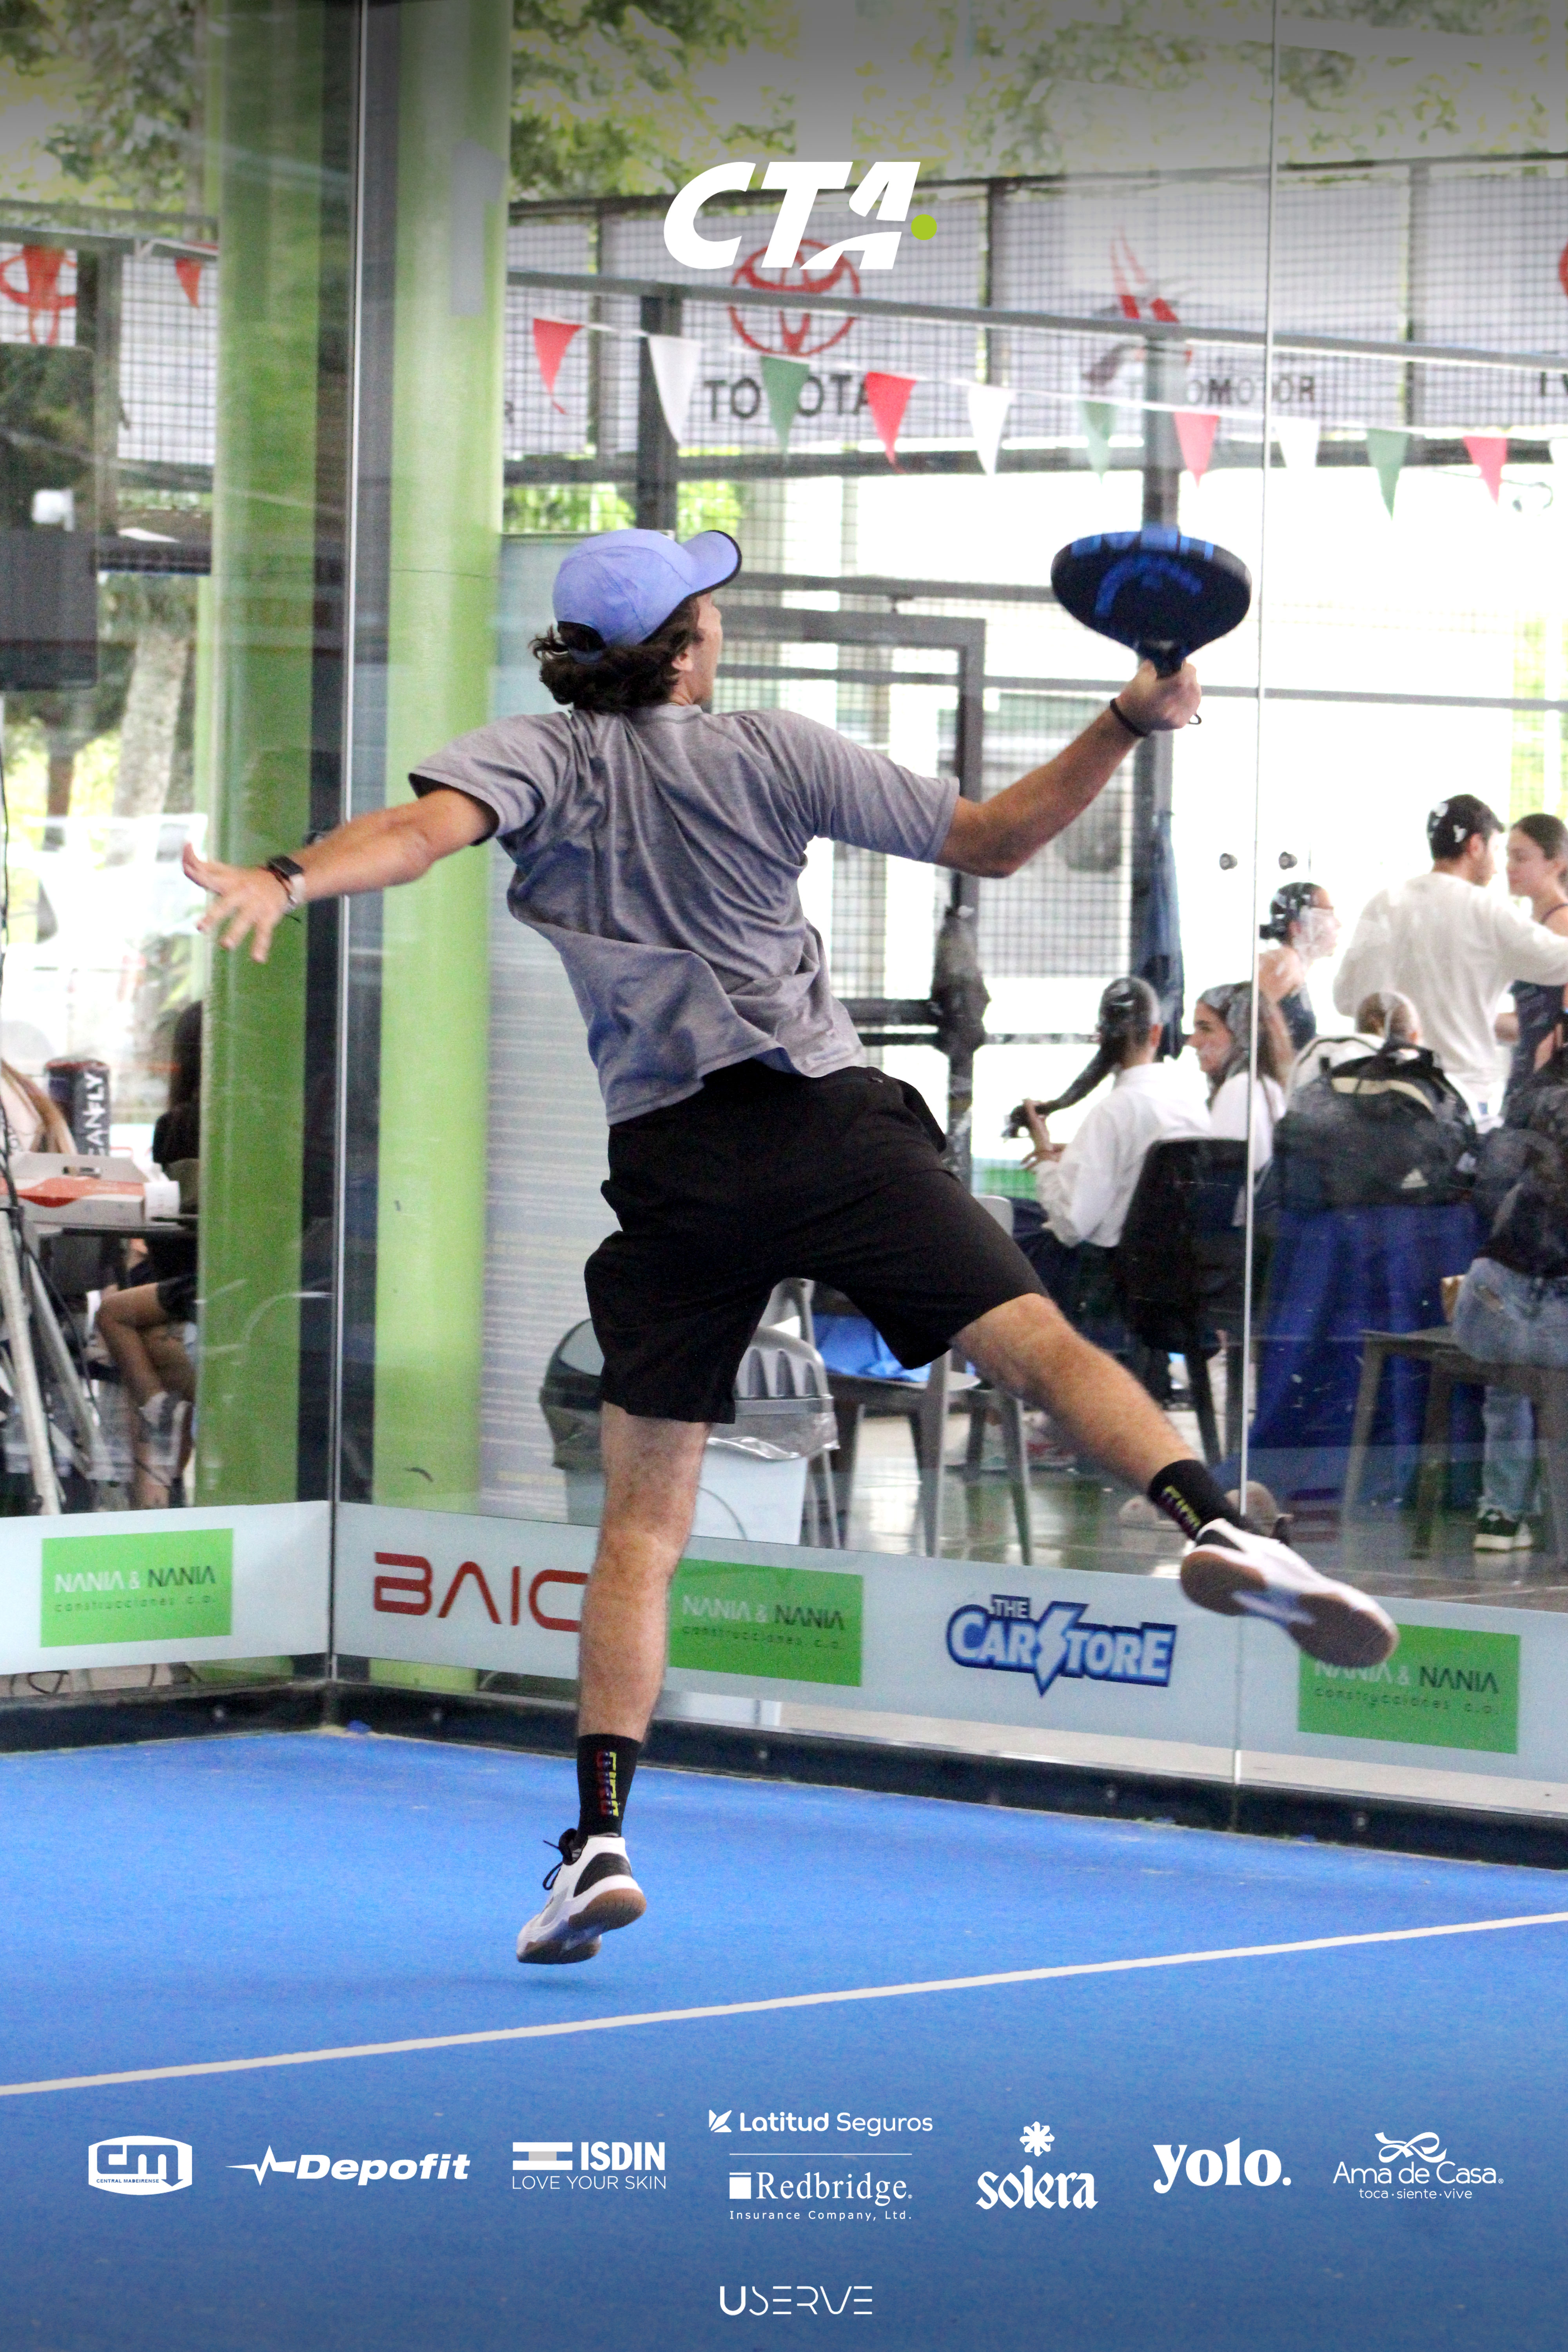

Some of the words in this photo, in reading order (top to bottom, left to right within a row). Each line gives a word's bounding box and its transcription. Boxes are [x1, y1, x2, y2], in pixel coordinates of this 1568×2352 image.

[704, 374, 868, 421] TOOT
[55, 1571, 125, 1593] NANIA
[129, 1571, 140, 1590] &
[148, 1565, 216, 1588] NANIA
[374, 1551, 588, 1632] BAIC
[682, 1595, 751, 1622] NANIA
[773, 1604, 844, 1630] NANIA
[993, 1598, 1029, 1619] THE
[1419, 1665, 1499, 1694] NANIA
